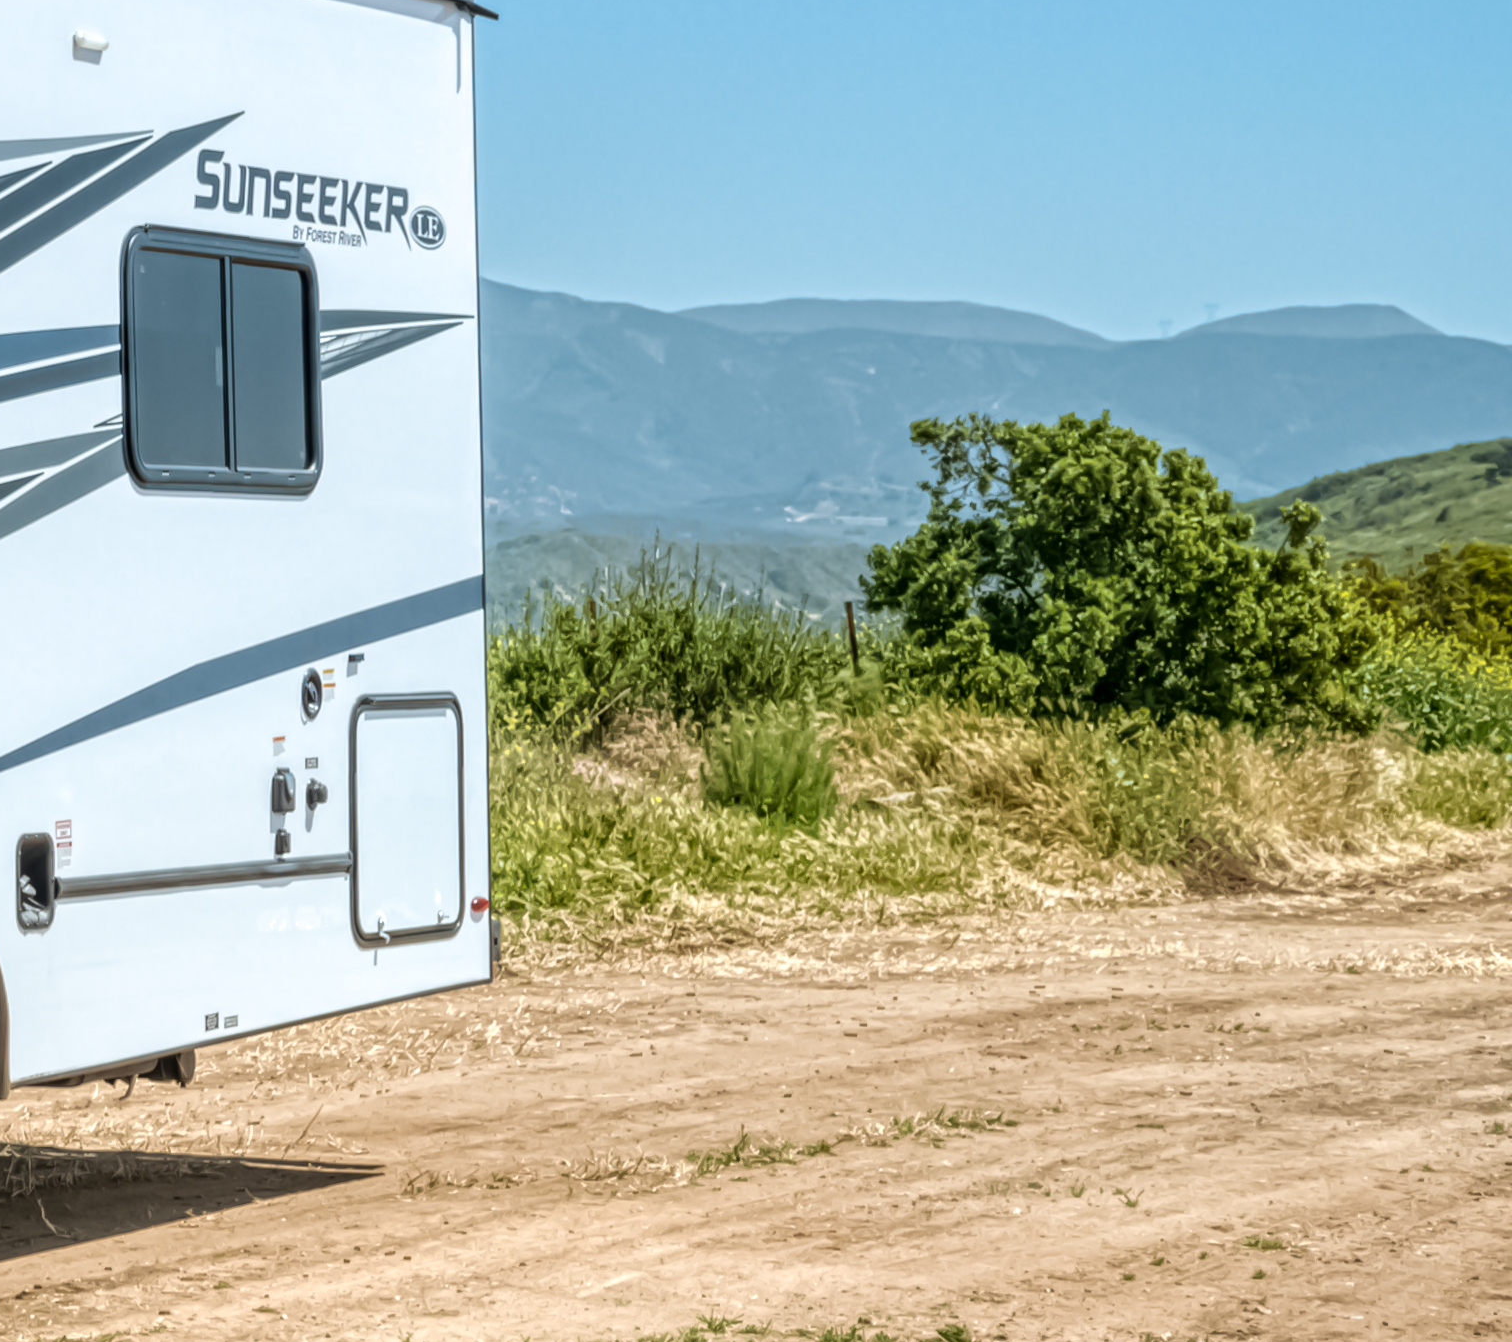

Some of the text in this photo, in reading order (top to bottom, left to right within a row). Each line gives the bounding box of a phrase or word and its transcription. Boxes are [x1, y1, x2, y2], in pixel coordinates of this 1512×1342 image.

[305, 226, 337, 245] FOREST
[338, 230, 362, 248] RIVER
[414, 213, 441, 240] LE
